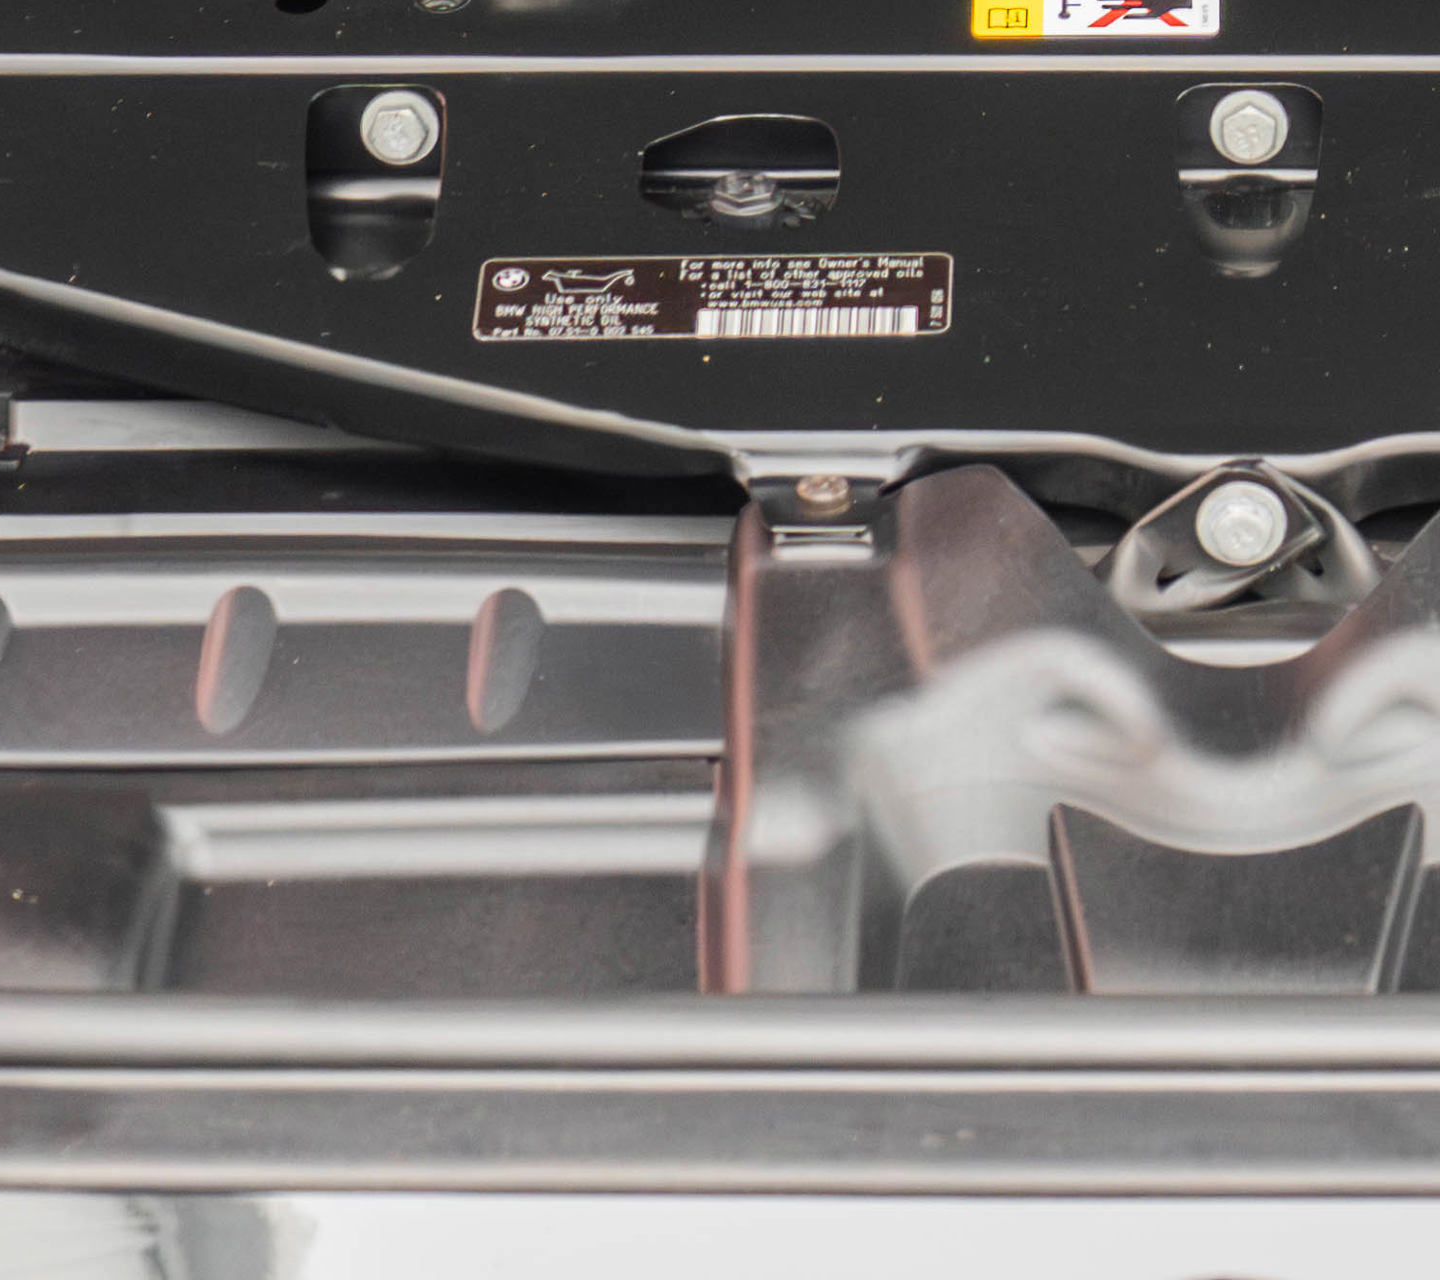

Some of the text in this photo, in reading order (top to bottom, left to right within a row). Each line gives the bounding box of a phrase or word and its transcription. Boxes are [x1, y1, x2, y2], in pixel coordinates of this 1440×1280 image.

[680, 256, 924, 271] For more info see Owner's Manual
[679, 268, 924, 281] For a list of other approved oils
[544, 292, 624, 306] Use only
[731, 288, 763, 299] visit
[771, 290, 793, 299] our
[800, 288, 827, 299] web
[834, 288, 861, 298] site
[869, 287, 884, 298] at
[495, 302, 660, 318] BMW HIGH PERFORMANCE
[525, 314, 622, 327] SYNTHETIC OIL
